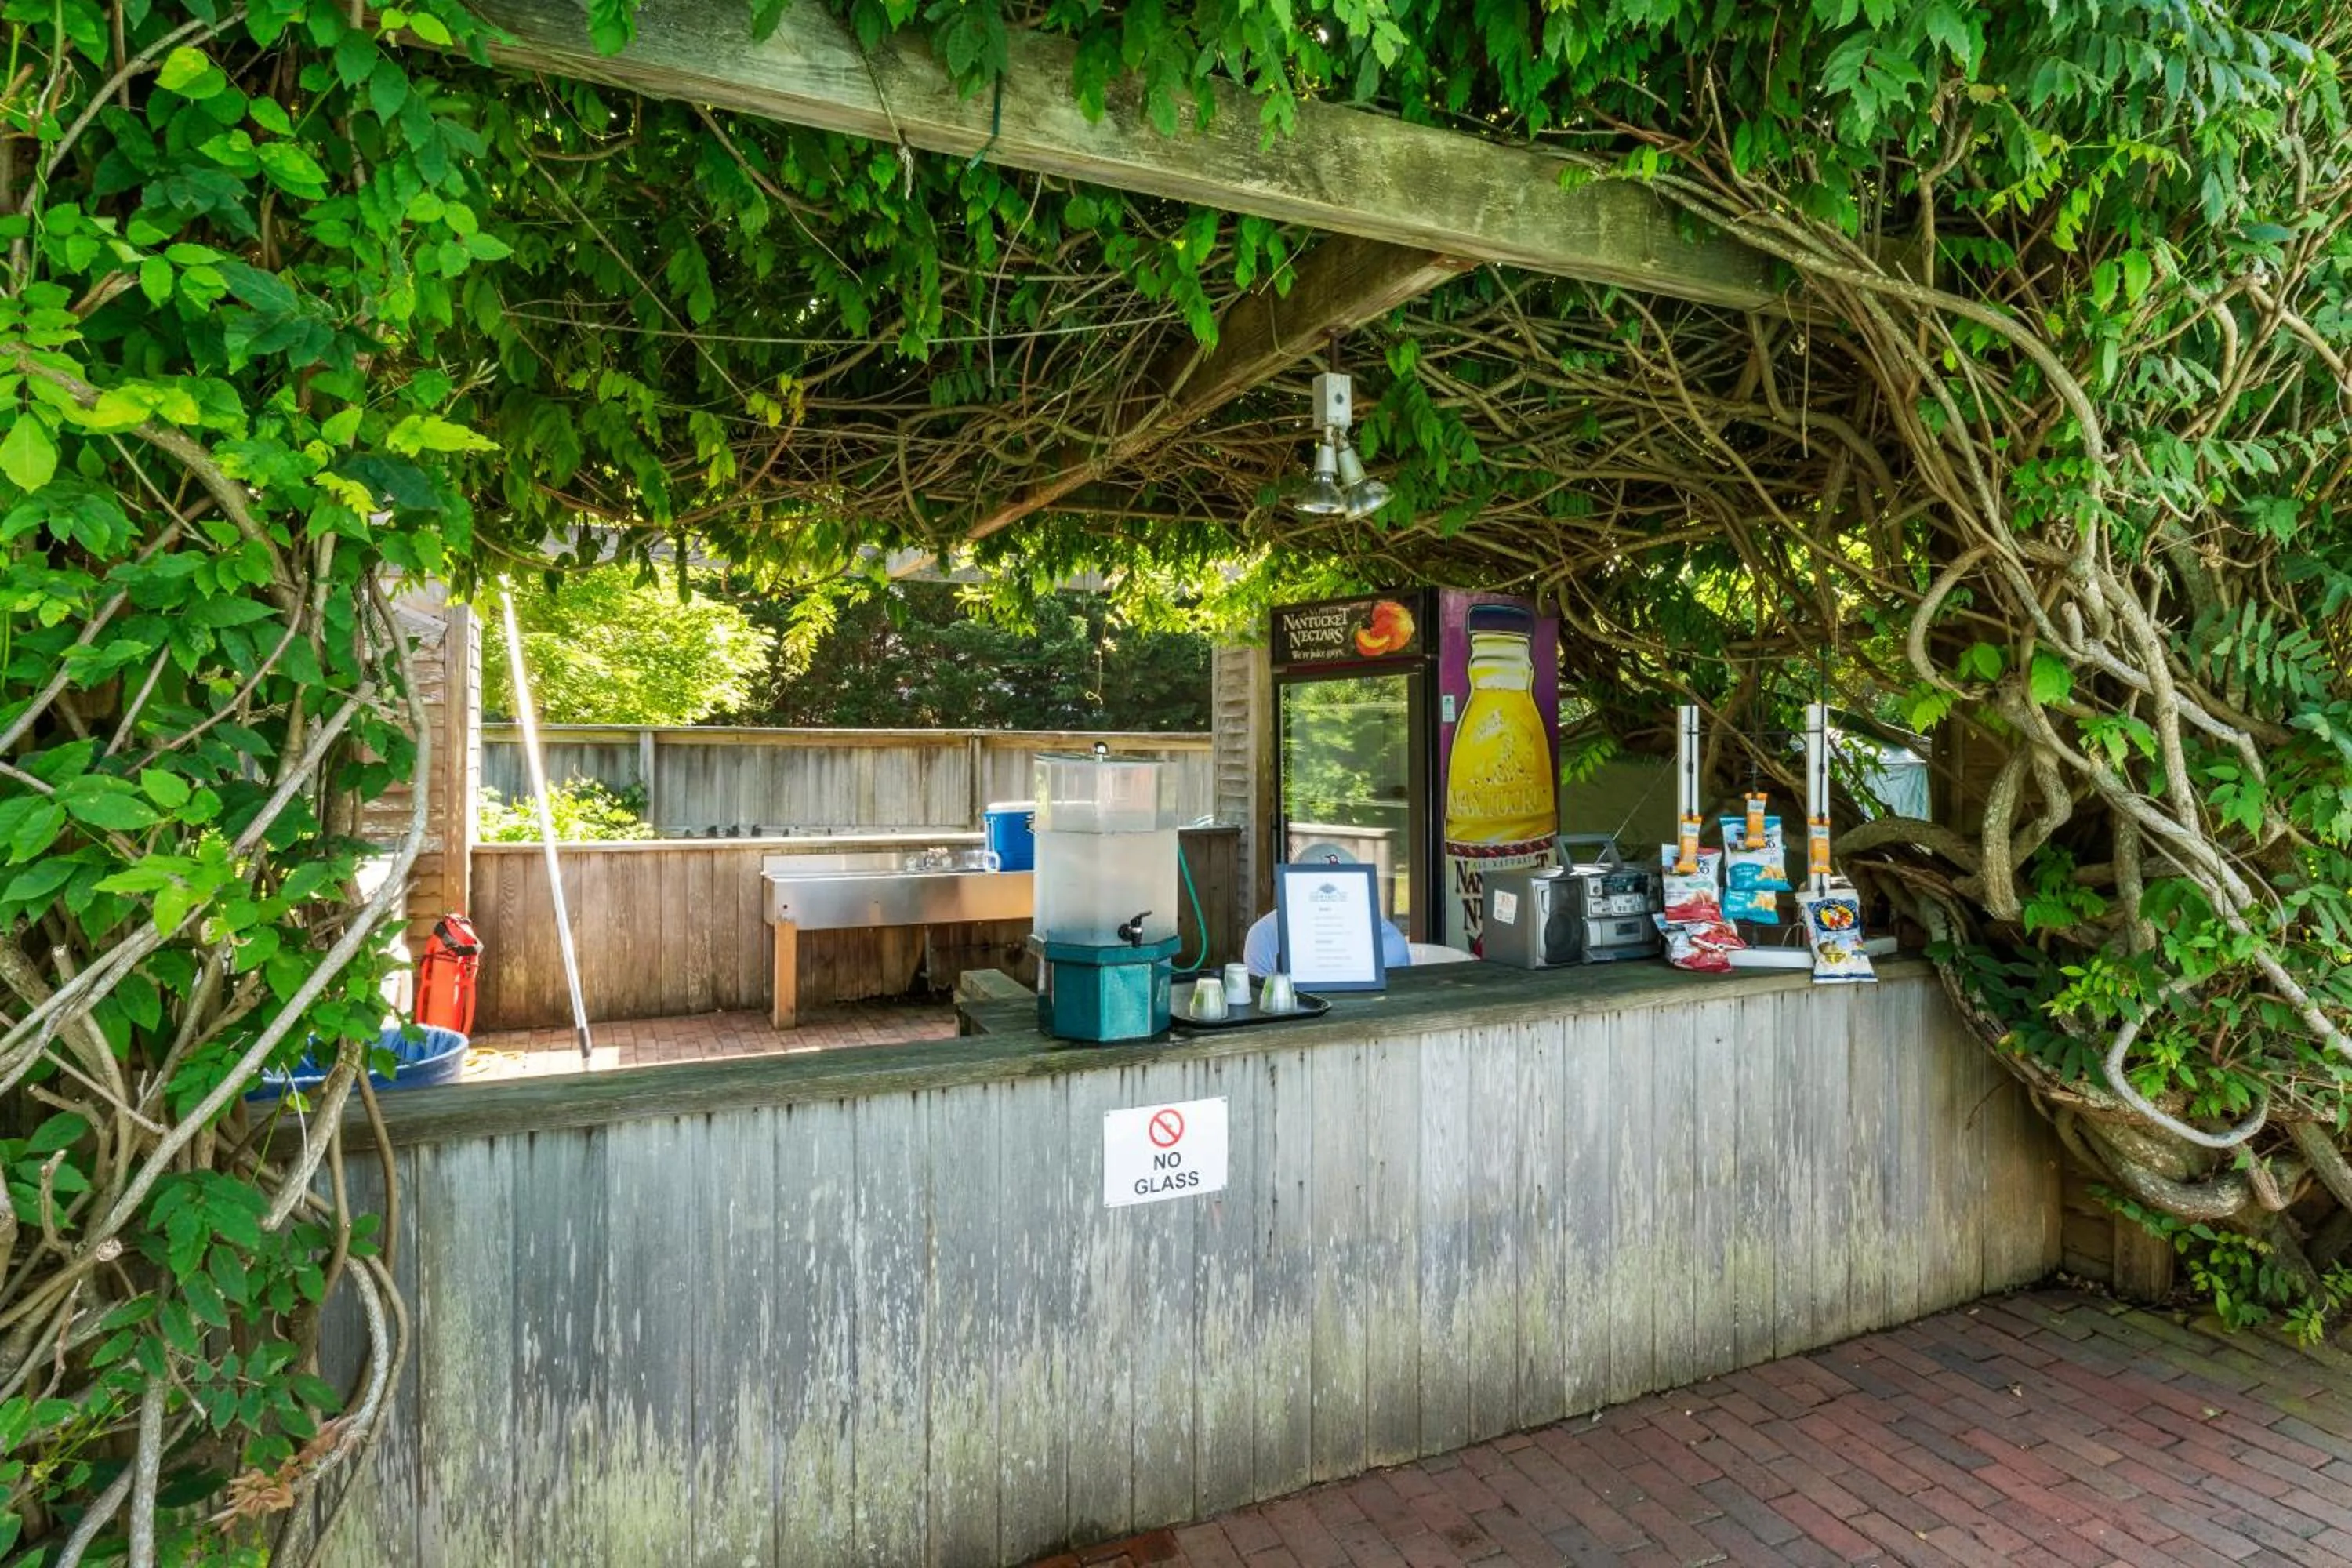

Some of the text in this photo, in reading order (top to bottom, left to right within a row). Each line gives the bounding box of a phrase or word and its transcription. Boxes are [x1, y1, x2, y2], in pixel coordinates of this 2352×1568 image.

[1283, 608, 1350, 630] NANTUCKET
[1289, 627, 1345, 648] NECTARS
[1154, 1152, 1181, 1171] NO
[1134, 1171, 1199, 1195] GLASS
